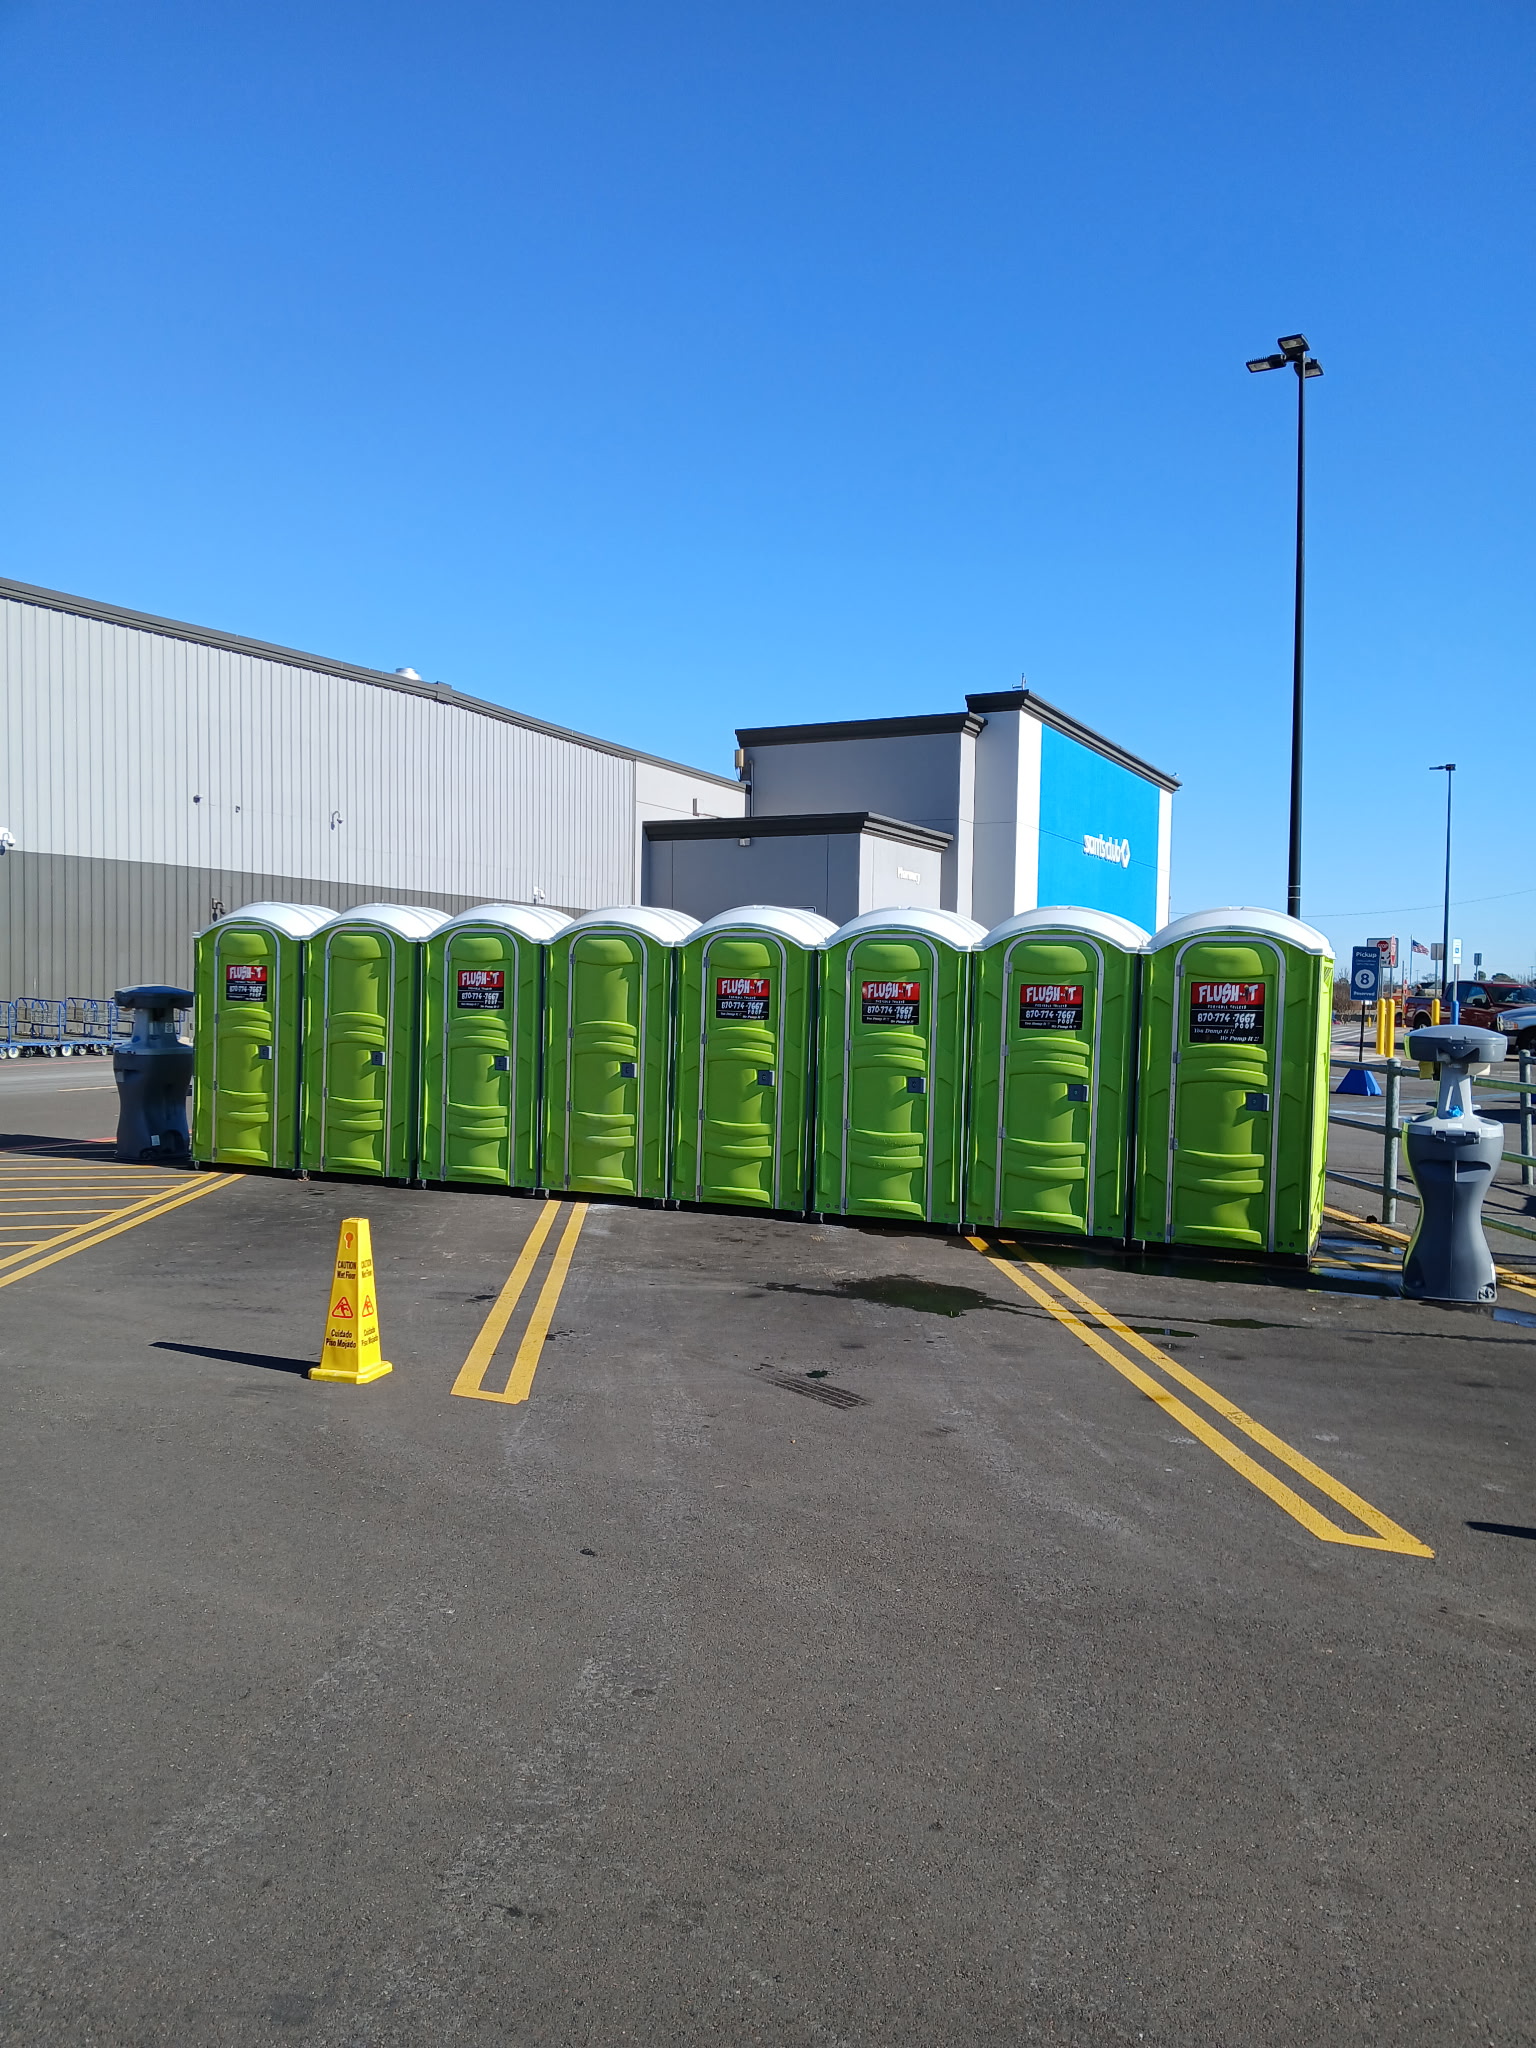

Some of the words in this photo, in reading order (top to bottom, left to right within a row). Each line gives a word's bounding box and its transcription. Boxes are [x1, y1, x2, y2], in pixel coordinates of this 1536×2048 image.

[1360, 973, 1370, 985] 8
[337, 1260, 357, 1270] CAUTION
[337, 1270, 345, 1278] Wet
[331, 1329, 352, 1338] Cuidado
[326, 1338, 336, 1346] Piso
[337, 1339, 356, 1349] Mojado
